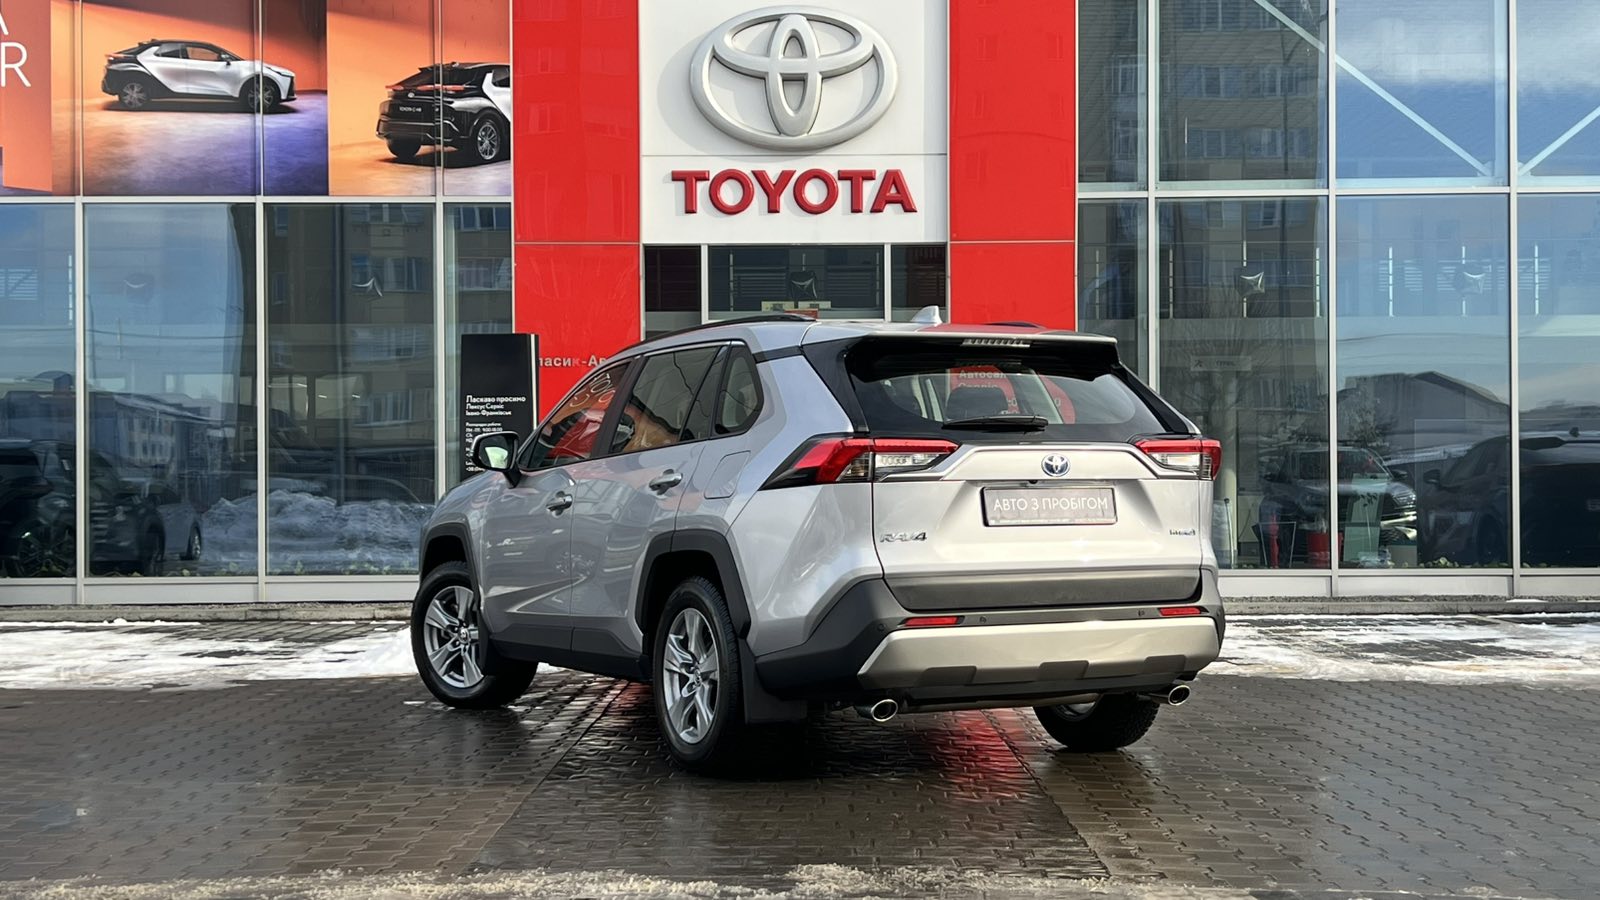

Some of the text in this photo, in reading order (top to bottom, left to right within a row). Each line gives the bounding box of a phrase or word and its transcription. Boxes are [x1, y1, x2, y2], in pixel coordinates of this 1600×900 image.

[671, 168, 918, 215] TOYOTA
[993, 498, 1028, 512] АВТО
[1042, 496, 1108, 511] ПРОБІГОМ
